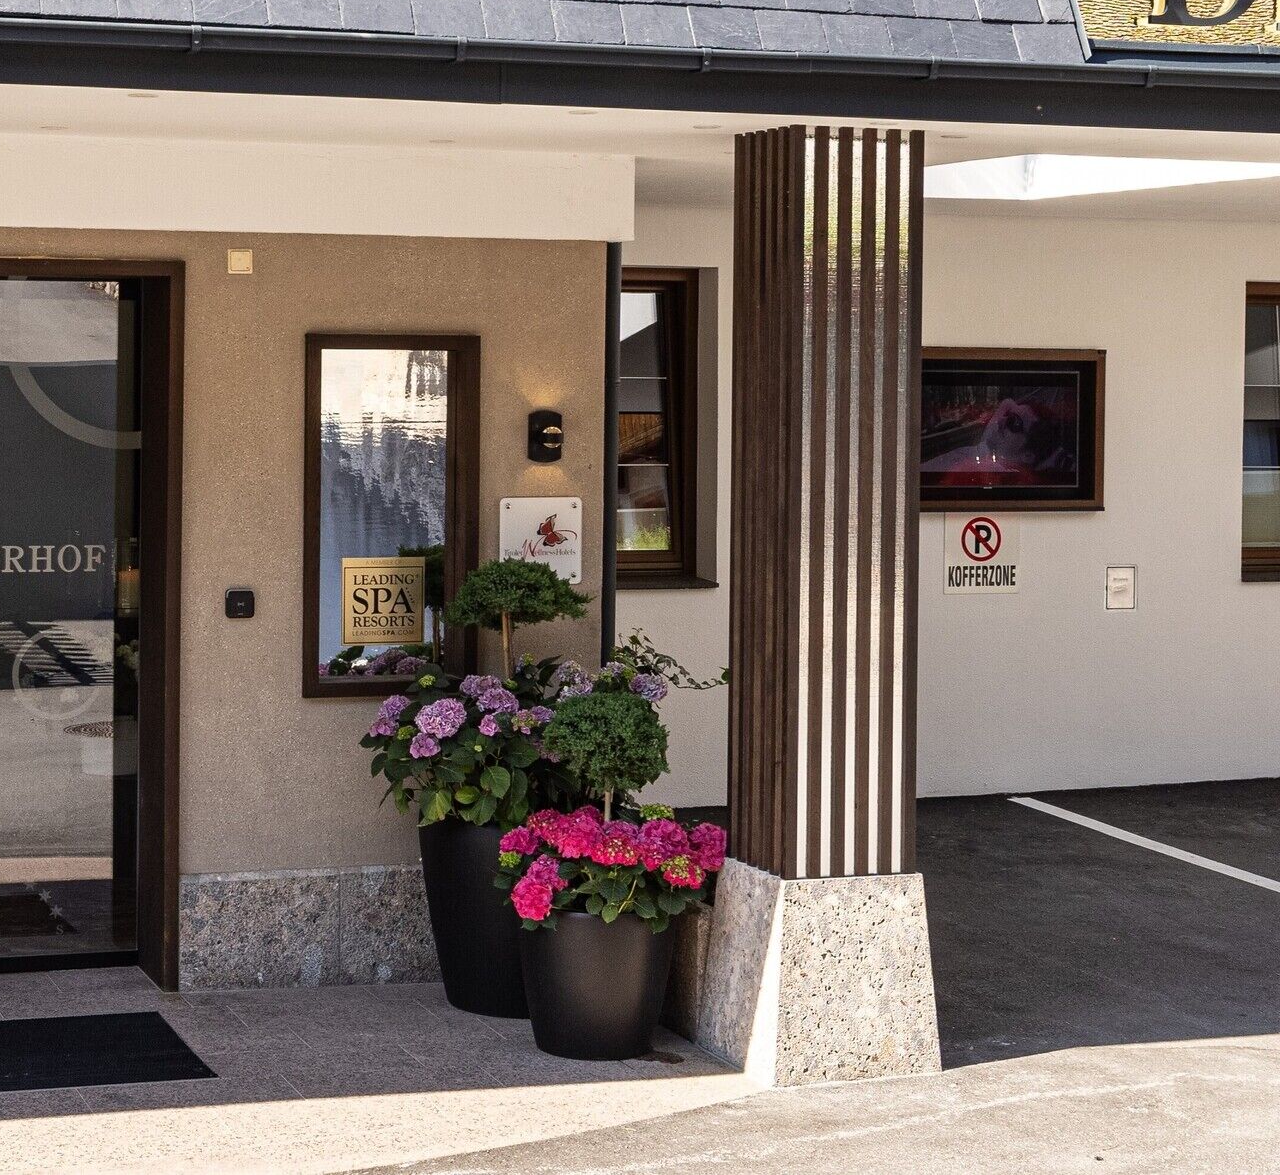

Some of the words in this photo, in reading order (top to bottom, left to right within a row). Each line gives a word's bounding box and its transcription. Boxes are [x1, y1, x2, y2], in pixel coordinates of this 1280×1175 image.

[353, 574, 414, 585] LEADING
[948, 565, 1016, 587] KOFFERZONE
[352, 587, 415, 615] SPA
[352, 616, 415, 627] RESORTS
